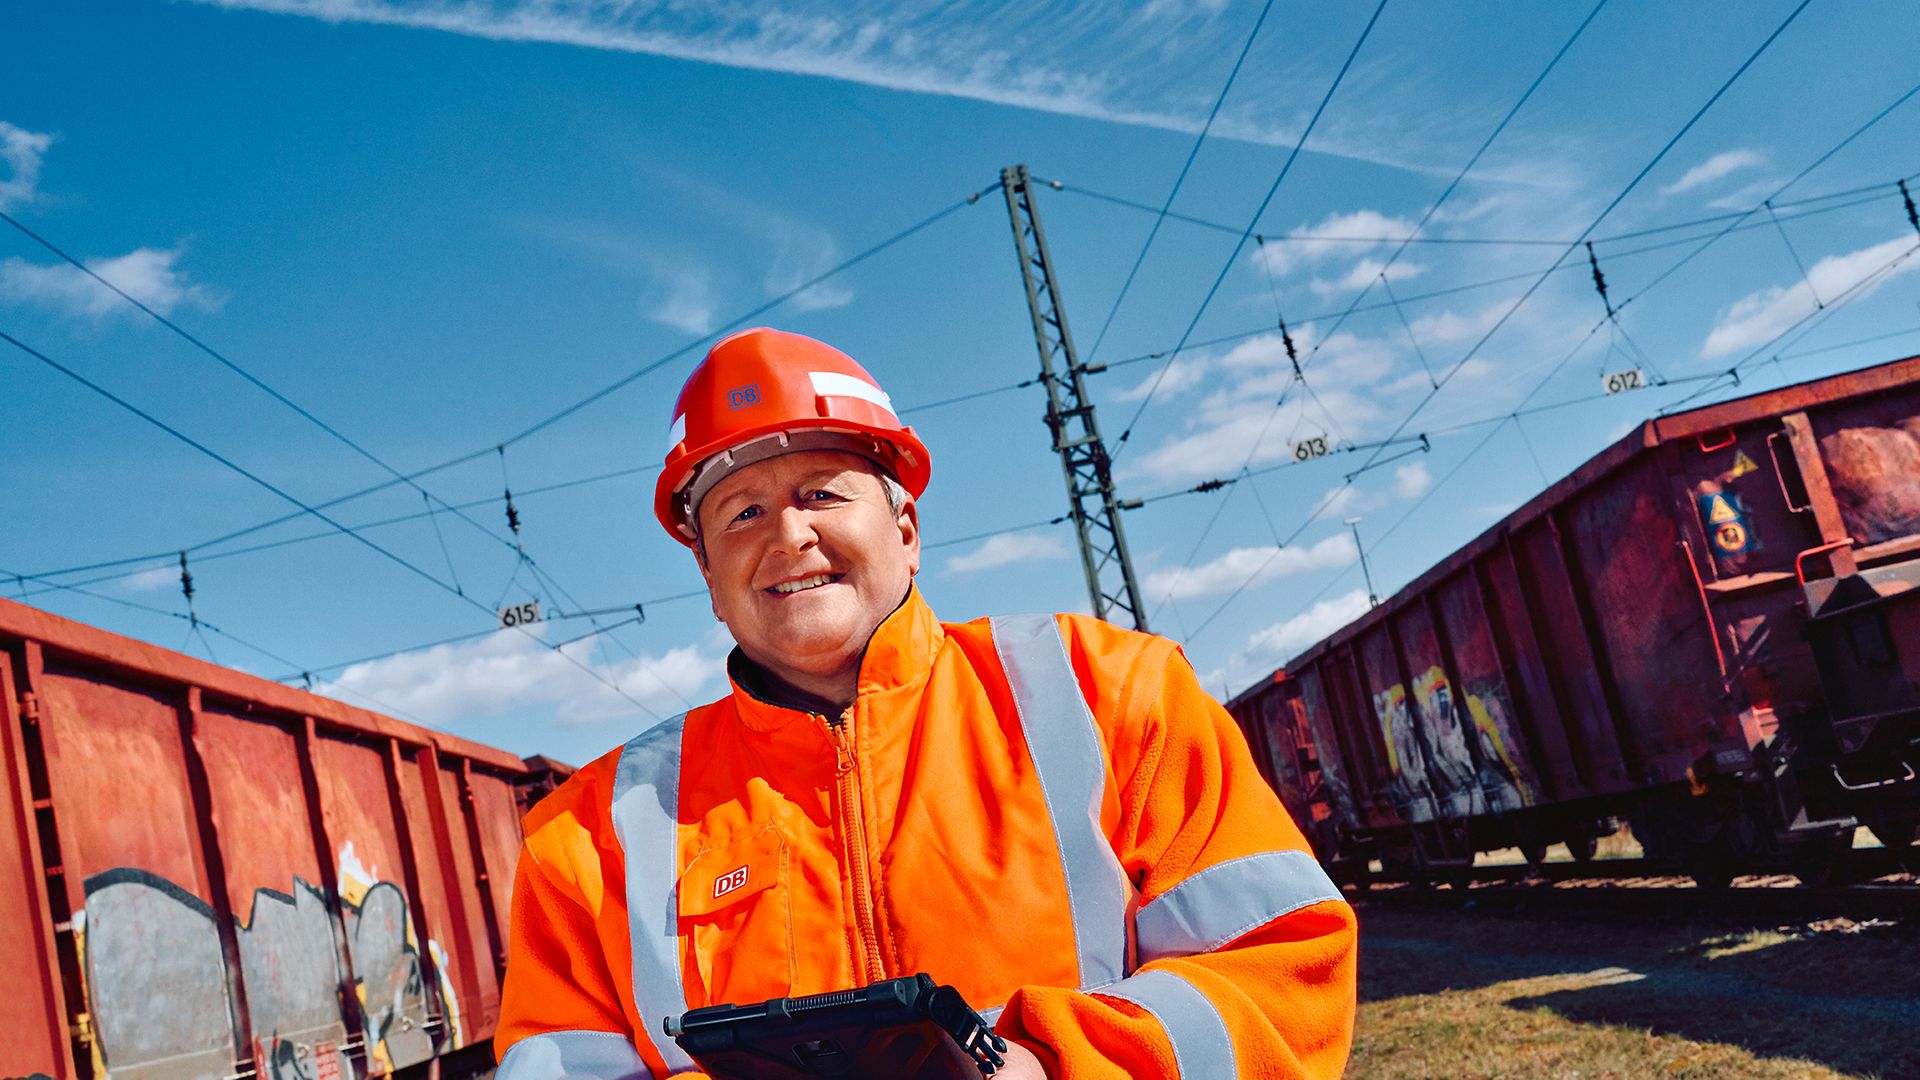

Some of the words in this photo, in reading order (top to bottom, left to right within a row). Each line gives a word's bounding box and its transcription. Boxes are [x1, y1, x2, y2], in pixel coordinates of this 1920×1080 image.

[1608, 371, 1641, 393] 612
[731, 387, 757, 407] DB
[1296, 437, 1326, 460] 613
[503, 603, 535, 627] 615
[717, 870, 745, 895] DB
